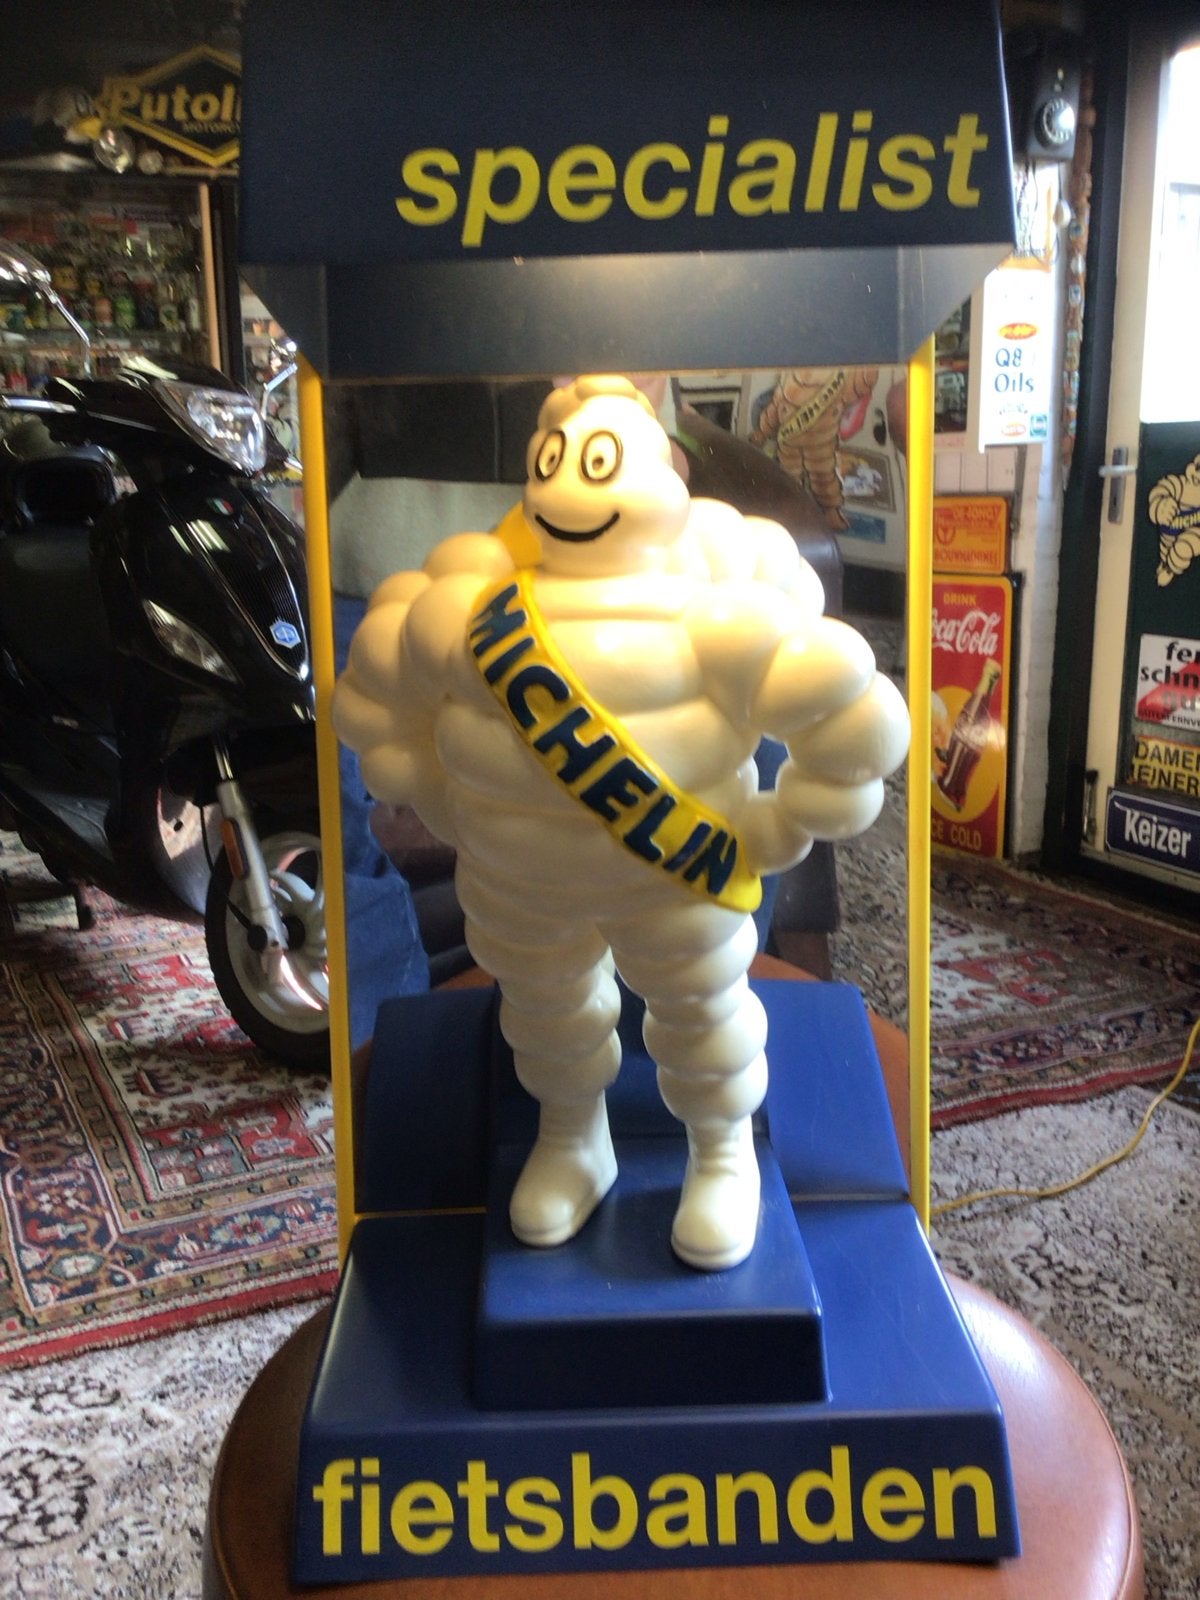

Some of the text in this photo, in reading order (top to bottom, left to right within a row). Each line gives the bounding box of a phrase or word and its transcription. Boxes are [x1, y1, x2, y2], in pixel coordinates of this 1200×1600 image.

[395, 110, 989, 248] specialist
[995, 347, 1023, 368] Q8
[994, 372, 1035, 393] Oils
[943, 592, 977, 606] DRINK
[469, 583, 738, 896] MICHELIN
[951, 824, 981, 851] COLD
[1124, 808, 1192, 859] Keizer
[313, 1444, 998, 1556] fietsbanden
